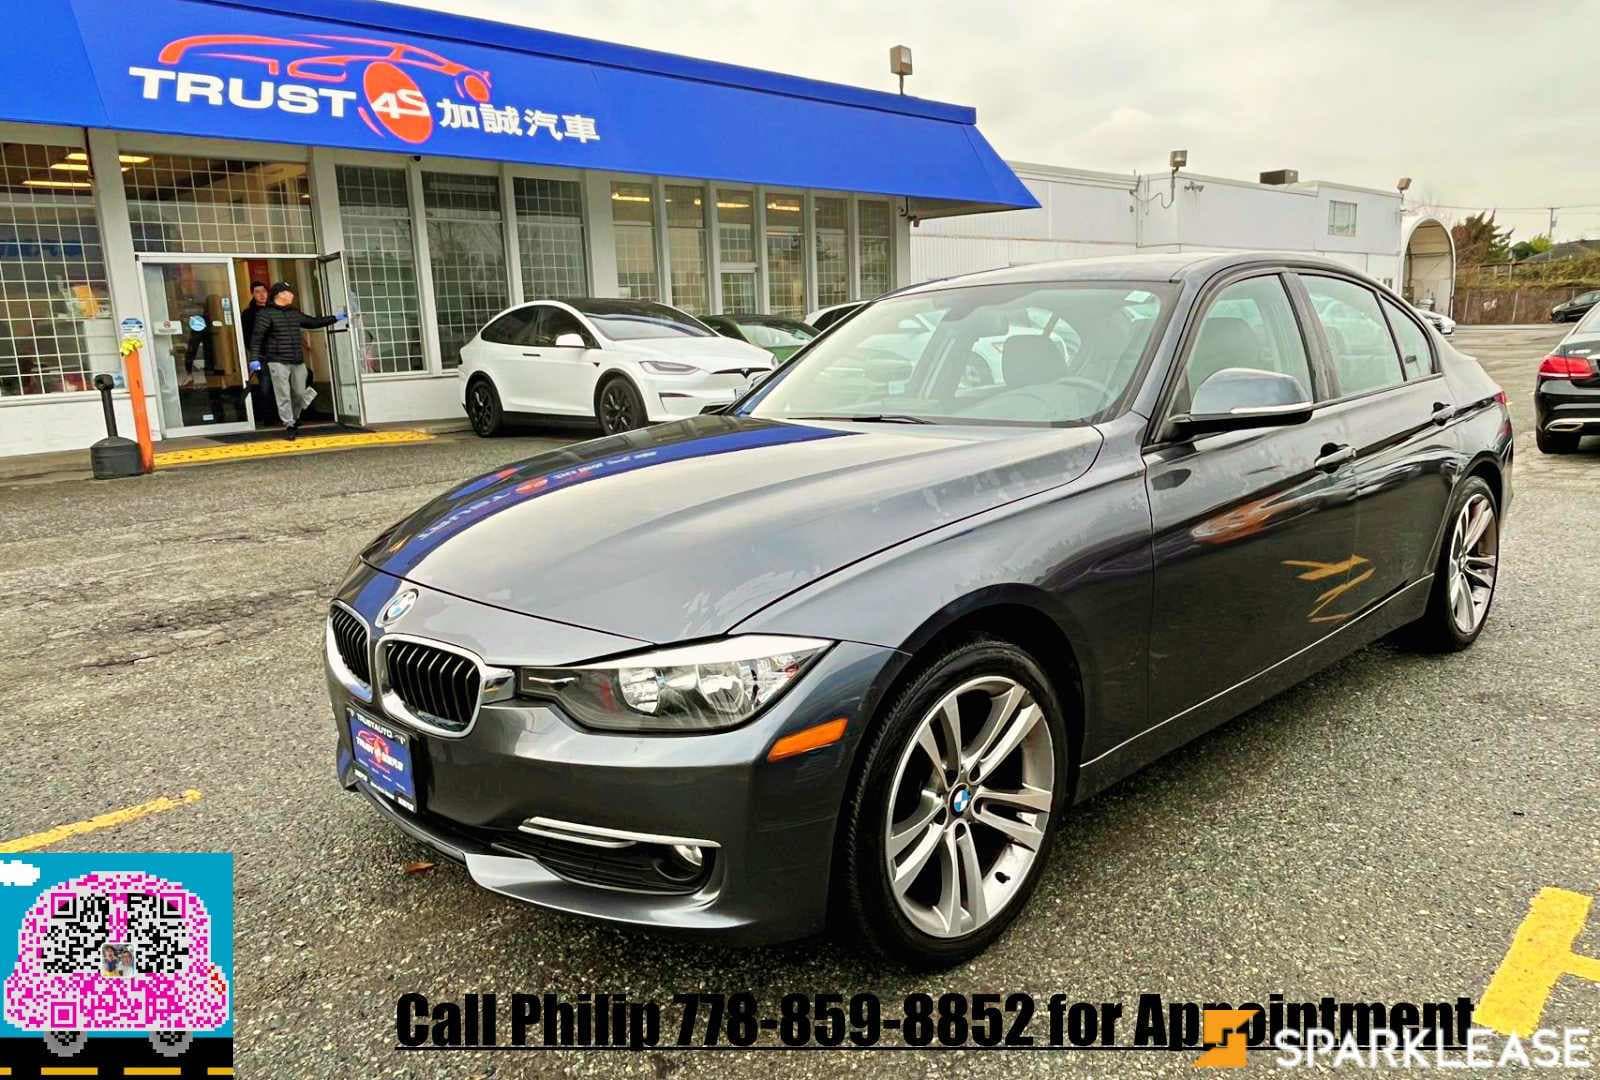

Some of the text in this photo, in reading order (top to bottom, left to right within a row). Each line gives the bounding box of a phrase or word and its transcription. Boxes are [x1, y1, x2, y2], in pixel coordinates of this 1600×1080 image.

[128, 66, 600, 143] TRUST 4S 加誠汽車
